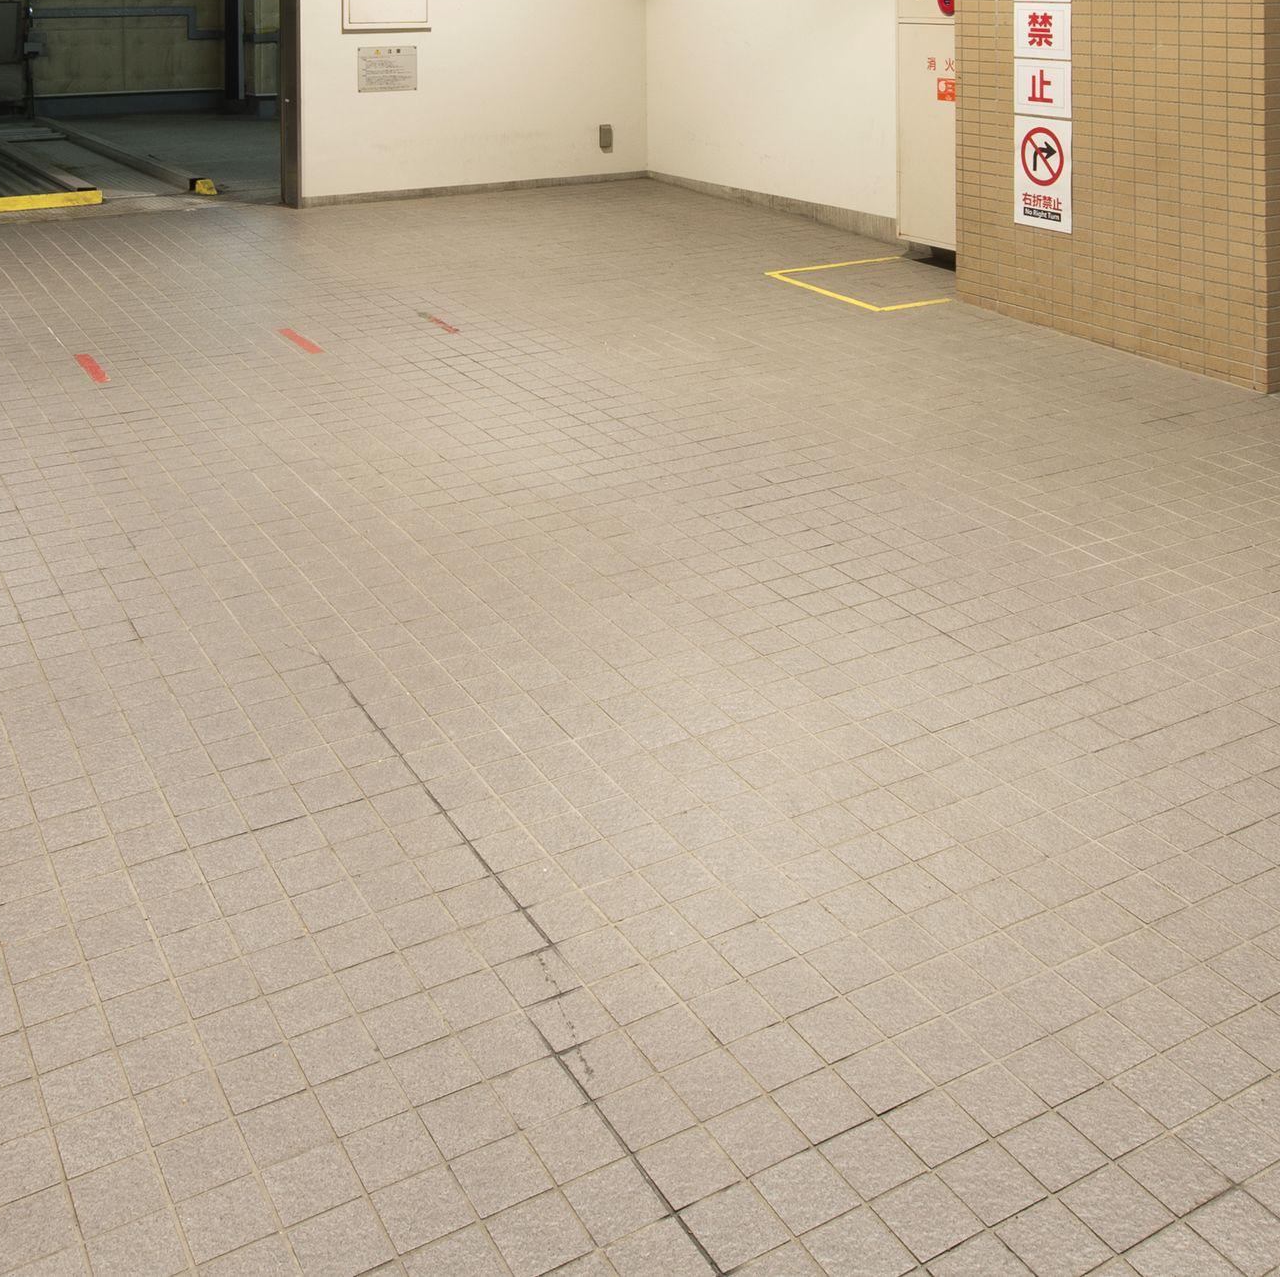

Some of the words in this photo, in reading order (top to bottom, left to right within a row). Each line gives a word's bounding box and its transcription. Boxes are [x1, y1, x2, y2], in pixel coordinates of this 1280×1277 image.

[1022, 192, 1063, 212] 右折禁止
[1024, 207, 1033, 216] No
[1032, 209, 1048, 219] Right
[1048, 212, 1060, 221] Turn
